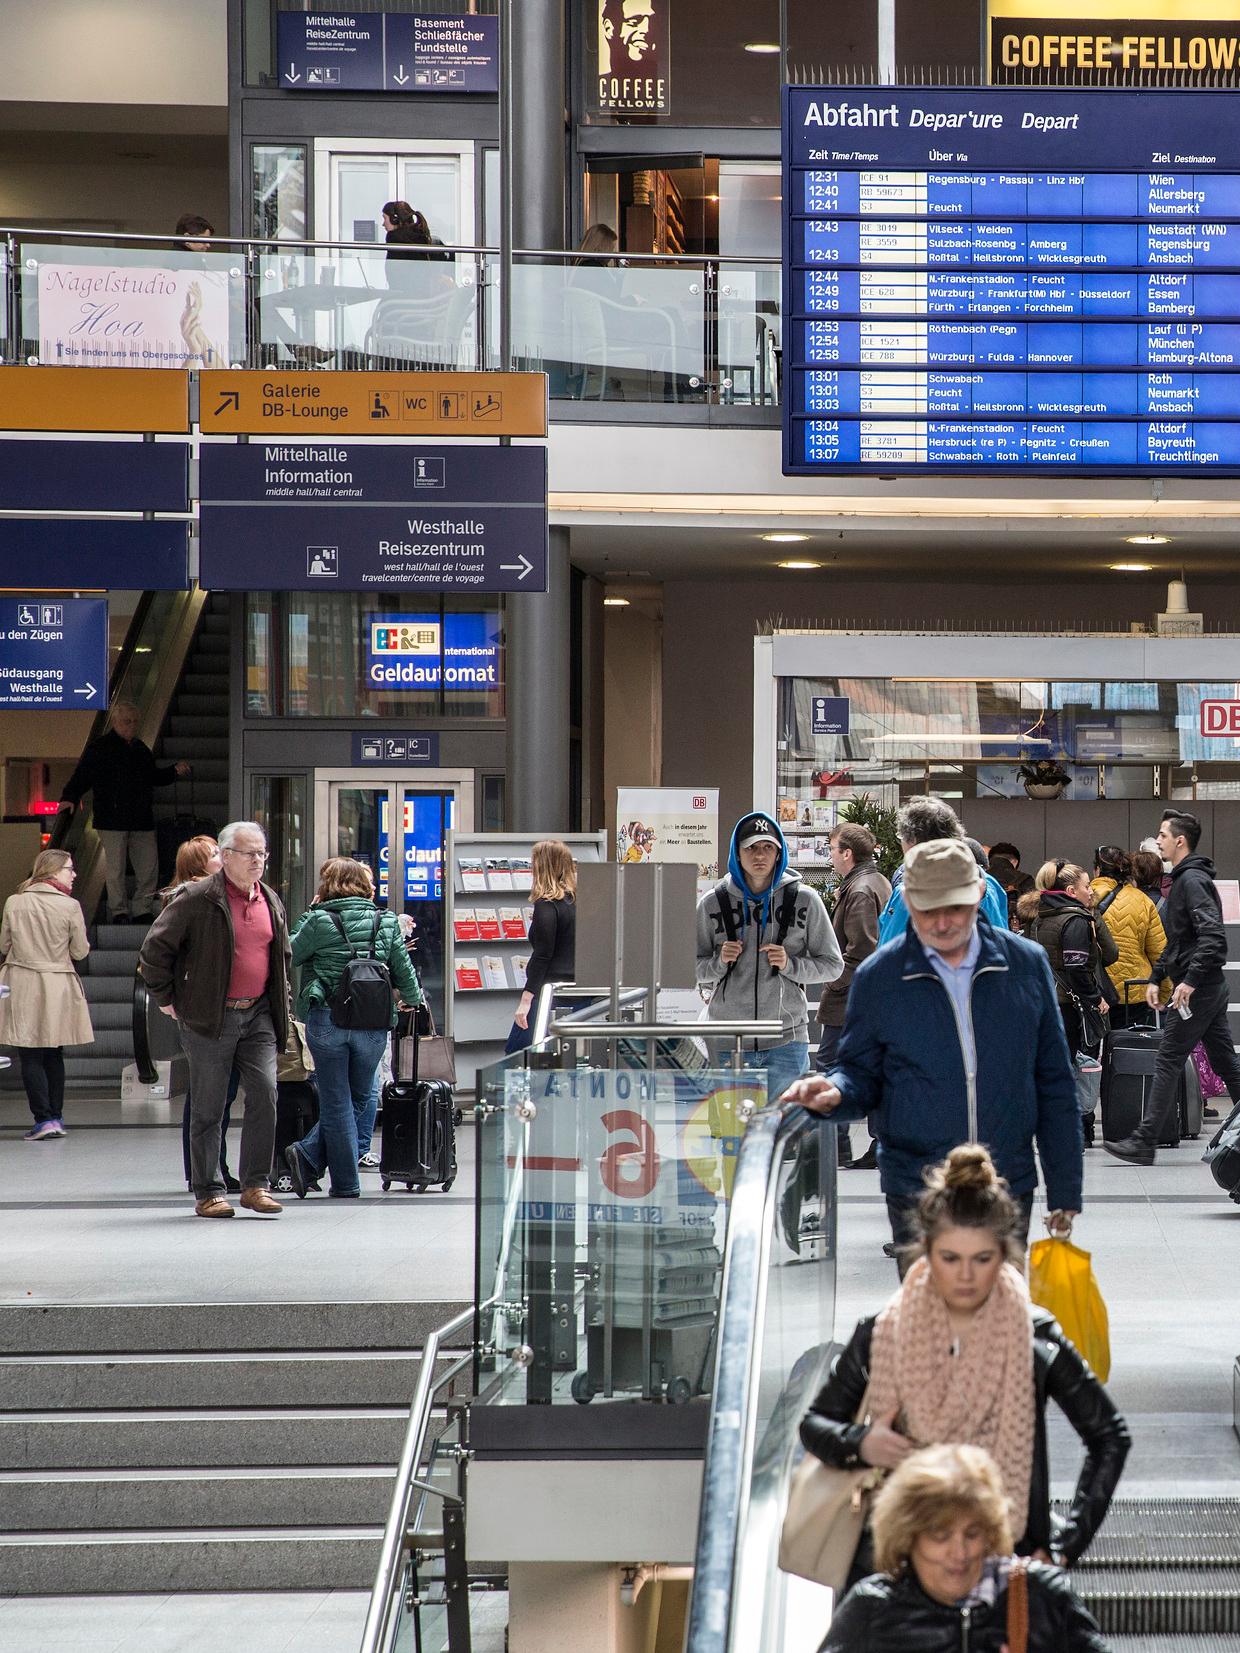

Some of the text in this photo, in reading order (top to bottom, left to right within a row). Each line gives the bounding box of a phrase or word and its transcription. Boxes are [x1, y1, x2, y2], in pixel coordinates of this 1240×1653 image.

[306, 16, 356, 26] Mittelhalle
[414, 18, 465, 28] Basement
[306, 29, 370, 39] ReiseZentrum
[414, 30, 485, 41] Schließfächer
[414, 42, 468, 53] Fundstelle
[1002, 34, 1112, 68] COFFEE
[600, 78, 664, 99] COFFEE
[600, 99, 665, 108] FELLOWS
[804, 102, 899, 127] Abfahrt
[1021, 111, 1079, 133] Depart
[809, 150, 879, 162] Zeit Time/Temps
[929, 149, 968, 161] Über Via
[1152, 152, 1216, 164] Ziel Destination
[809, 171, 839, 182] 12:31
[929, 175, 986, 186] Regensburg
[1149, 175, 1175, 185] Wien
[809, 185, 839, 196] 12:40
[1149, 189, 1205, 202] Allersberg
[809, 199, 839, 211] 12:41
[929, 203, 962, 212] Feucht
[1149, 203, 1199, 214] Neumarkt
[809, 221, 839, 232] 12:43
[929, 238, 1016, 250] Sulzbach-Rosenbg
[1149, 239, 1210, 251] Regensburg
[1149, 253, 1193, 263] Ansbach
[809, 271, 839, 282] 12:44
[929, 275, 1014, 285] N.-Frankenstadion
[1149, 274, 1186, 285] Altdorf
[46, 270, 177, 299] Nagelstudio
[809, 285, 839, 296] 12:49
[929, 288, 1131, 300] Würzburg Düsseldorf
[968, 303, 1011, 315] Erlangen
[1149, 303, 1195, 315] Bamberg
[69, 302, 145, 337] Hoa
[809, 321, 839, 332] 12:53
[929, 323, 987, 334] Röthenbach
[1149, 338, 1194, 349] München
[65, 347, 204, 361] Sie finden uns im Obergeschoss
[809, 349, 839, 360] 12:58
[1028, 353, 1073, 362] Hannover
[1149, 352, 1233, 364] Hamburg-Altona
[809, 370, 839, 382] 13:01
[929, 373, 983, 383] Schwabach
[1149, 374, 1172, 384] Roth
[262, 383, 321, 398] Galerie
[406, 398, 427, 410] WC
[809, 399, 839, 410] 13:03
[1038, 402, 1106, 414] Wicklesgreuth
[262, 402, 348, 421] DB-Lounge
[809, 434, 839, 445] 13:05
[929, 437, 1109, 448] Hersbruck Creußen
[265, 446, 347, 463] Mittelhalle
[809, 448, 839, 459] 13:07
[1032, 452, 1076, 461] Pleinfeld
[1149, 451, 1219, 463] Treuchtlingen
[265, 468, 353, 484] Information
[266, 487, 363, 497] middle hall/hall central
[408, 519, 485, 535] Westhalle
[379, 541, 485, 556] Reisezentrum
[384, 562, 485, 572] west hall/hall l'ouest
[362, 573, 485, 584] travelcenter/centre voyage
[8, 630, 63, 641] den Zügen
[445, 646, 495, 656] nternational
[0, 668, 63, 680] üdausgang
[371, 662, 495, 682] Geldautomat
[10, 683, 63, 693] Westhalle
